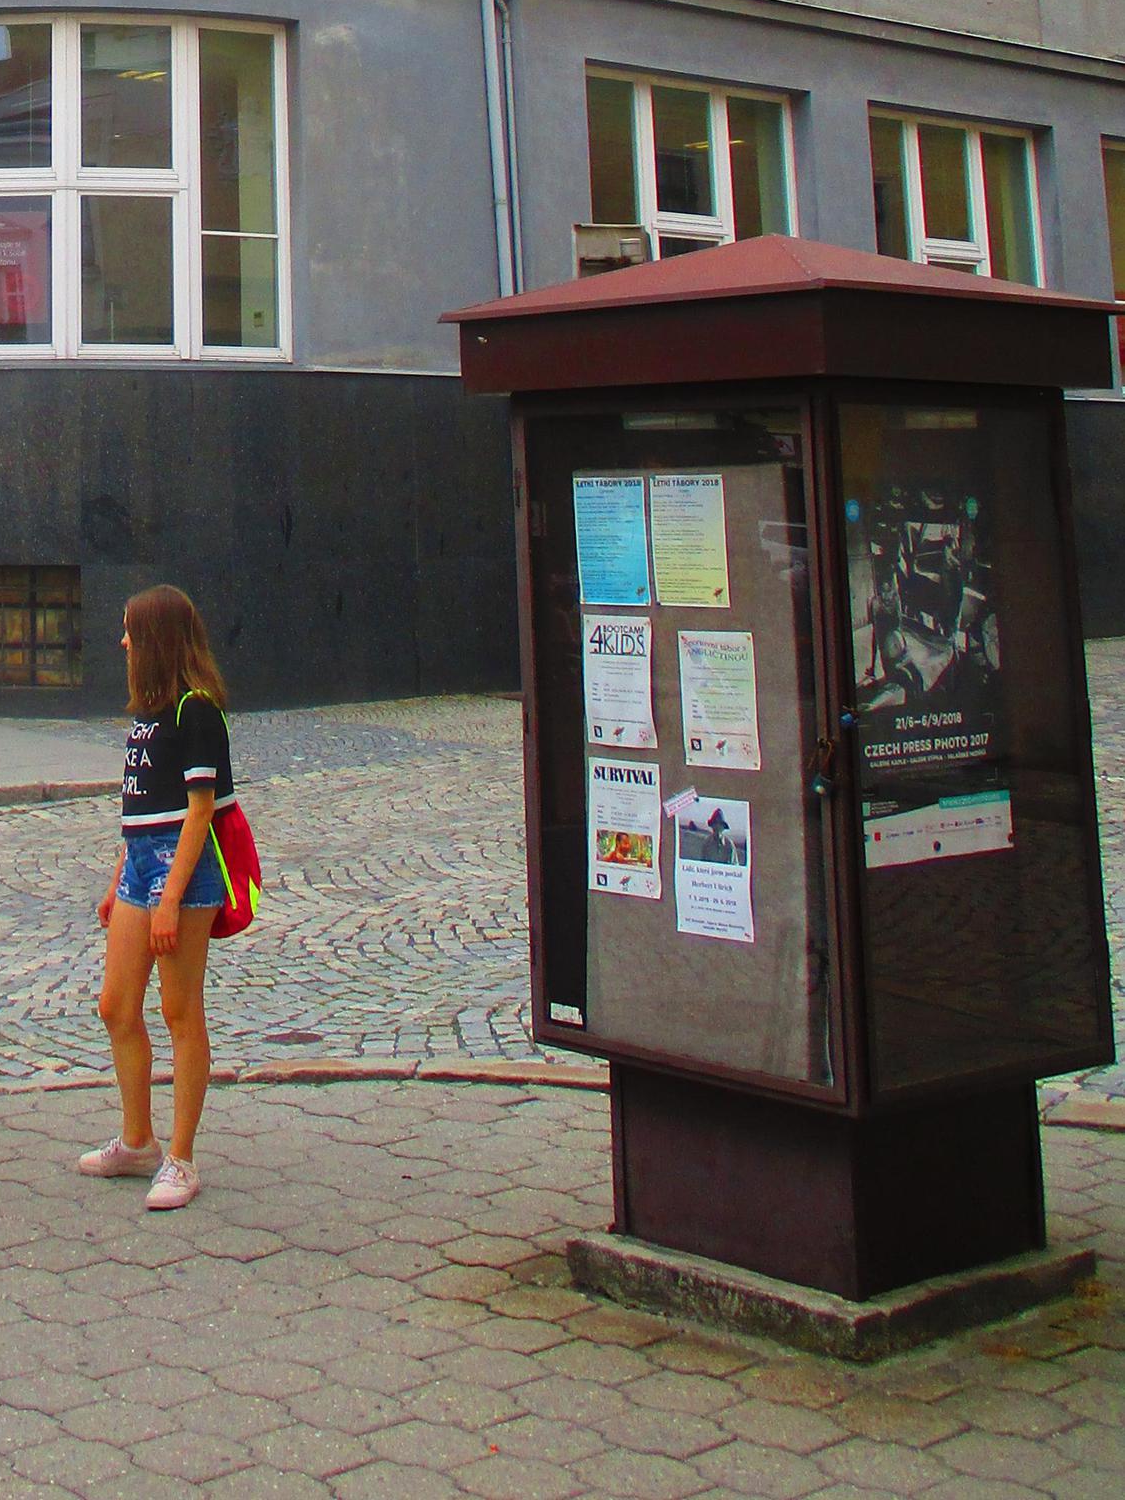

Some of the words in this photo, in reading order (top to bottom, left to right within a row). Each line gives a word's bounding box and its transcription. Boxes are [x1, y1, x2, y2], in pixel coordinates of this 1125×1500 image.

[672, 479, 699, 487] TÁBORY
[701, 479, 719, 487] 2018
[603, 625, 645, 634] BOOTCAMP
[131, 721, 160, 740] GHT
[864, 742, 901, 758] CZECH
[902, 738, 932, 754] PRESS
[934, 735, 969, 750] PHOTO
[970, 733, 990, 746] 2017
[124, 747, 138, 767] KE
[140, 747, 152, 767] A
[594, 765, 656, 786] SURVIVAL
